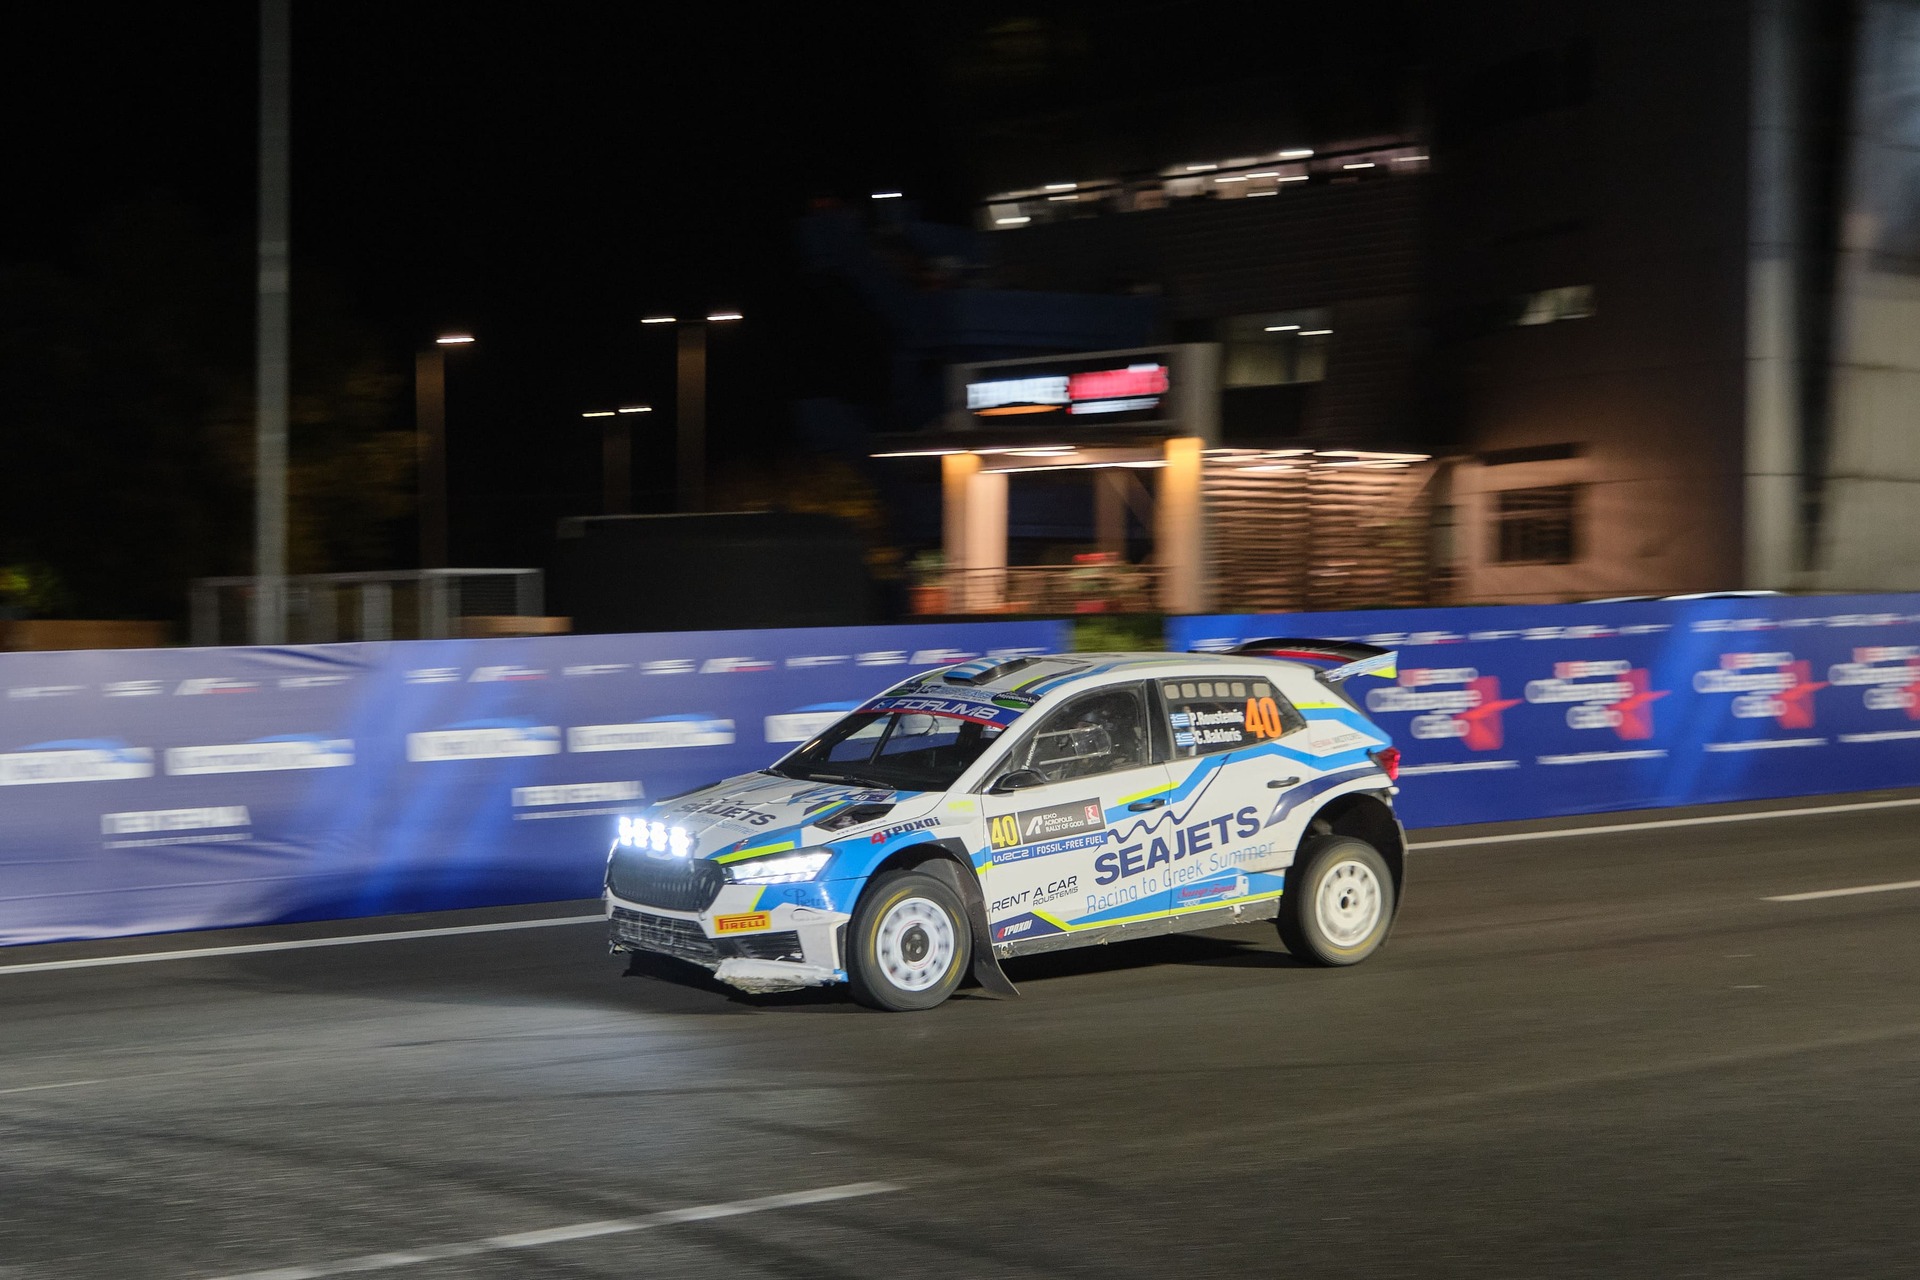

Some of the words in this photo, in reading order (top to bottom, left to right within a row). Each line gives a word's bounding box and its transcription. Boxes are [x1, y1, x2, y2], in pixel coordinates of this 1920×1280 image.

[889, 698, 1000, 720] FORUM8
[1245, 696, 1282, 739] 40
[674, 802, 777, 826] SEAJETS
[1044, 816, 1074, 827] ACROPOLIS
[1045, 824, 1061, 833] RALLY
[1061, 822, 1070, 830] OF
[1069, 820, 1085, 828] GODS
[991, 815, 1019, 848] 40
[993, 849, 1029, 863] WRC2
[1036, 838, 1084, 855] FOSSIL-FREE
[1085, 835, 1105, 846] FUEL
[1094, 806, 1261, 886] SEAJETS
[1086, 884, 1138, 914] Racing
[1142, 876, 1157, 895] to
[1162, 861, 1204, 888] Greek
[1209, 841, 1276, 873] Summer
[991, 890, 1030, 913] RENT
[1033, 887, 1044, 900] A
[1047, 875, 1078, 894] CAR
[1032, 886, 1079, 907] ROUSTEMIS
[719, 914, 766, 931] PIRELLI
